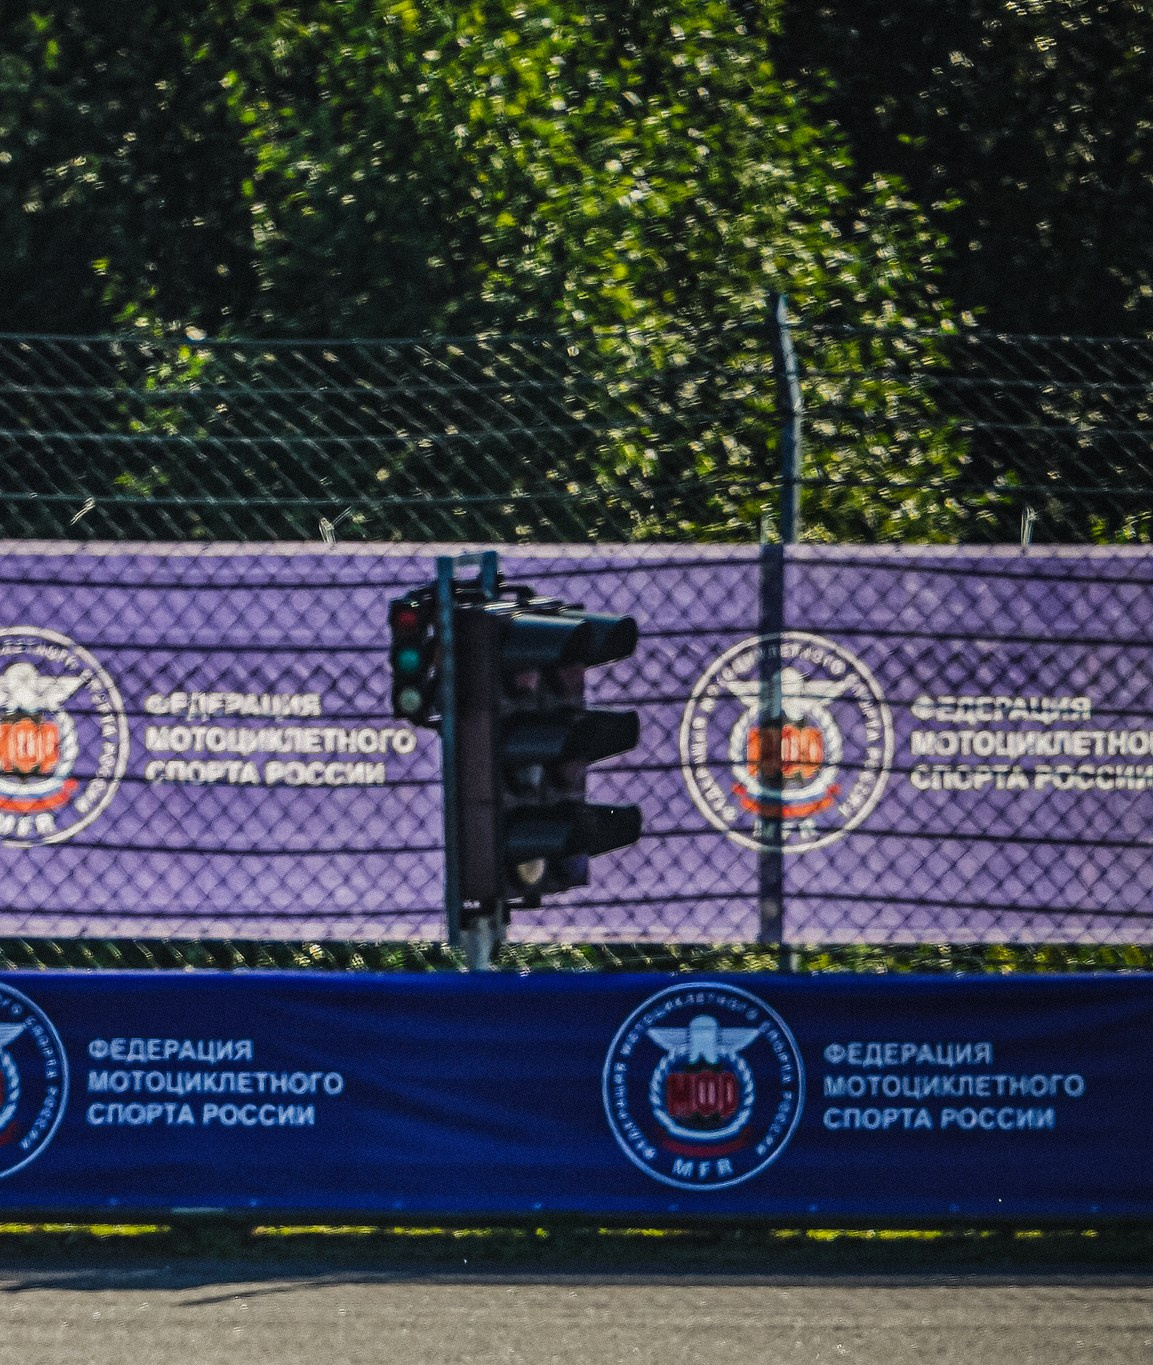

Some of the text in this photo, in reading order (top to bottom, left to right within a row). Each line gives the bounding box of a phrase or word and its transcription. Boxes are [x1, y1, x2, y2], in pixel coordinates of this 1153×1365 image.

[145, 692, 322, 721] ФЕДЕРАЦИЯ
[910, 696, 1092, 725] ФЕДЕРАЦИЯ
[145, 725, 418, 756] МОТОЦИКЛЕТНОГО
[910, 730, 1153, 758] МОТОЦИКЛЕТНО
[145, 760, 386, 785] СПОРТА РОССИИ
[910, 763, 1030, 790] СПОРТА
[88, 1038, 253, 1063] ФЕДЕРАЦИЯ
[823, 1041, 993, 1067] ФЕДЕРАЦИЯ
[87, 1070, 344, 1095] МОТОЦИКЛЕТНОГО
[823, 1074, 1085, 1099] МОТОЦИКЛЕТНОГО
[87, 1102, 315, 1126] СПОРТА РОССИИ
[823, 1107, 1056, 1130] СПОРТА РОССИИ
[672, 1158, 734, 1178] MFR
